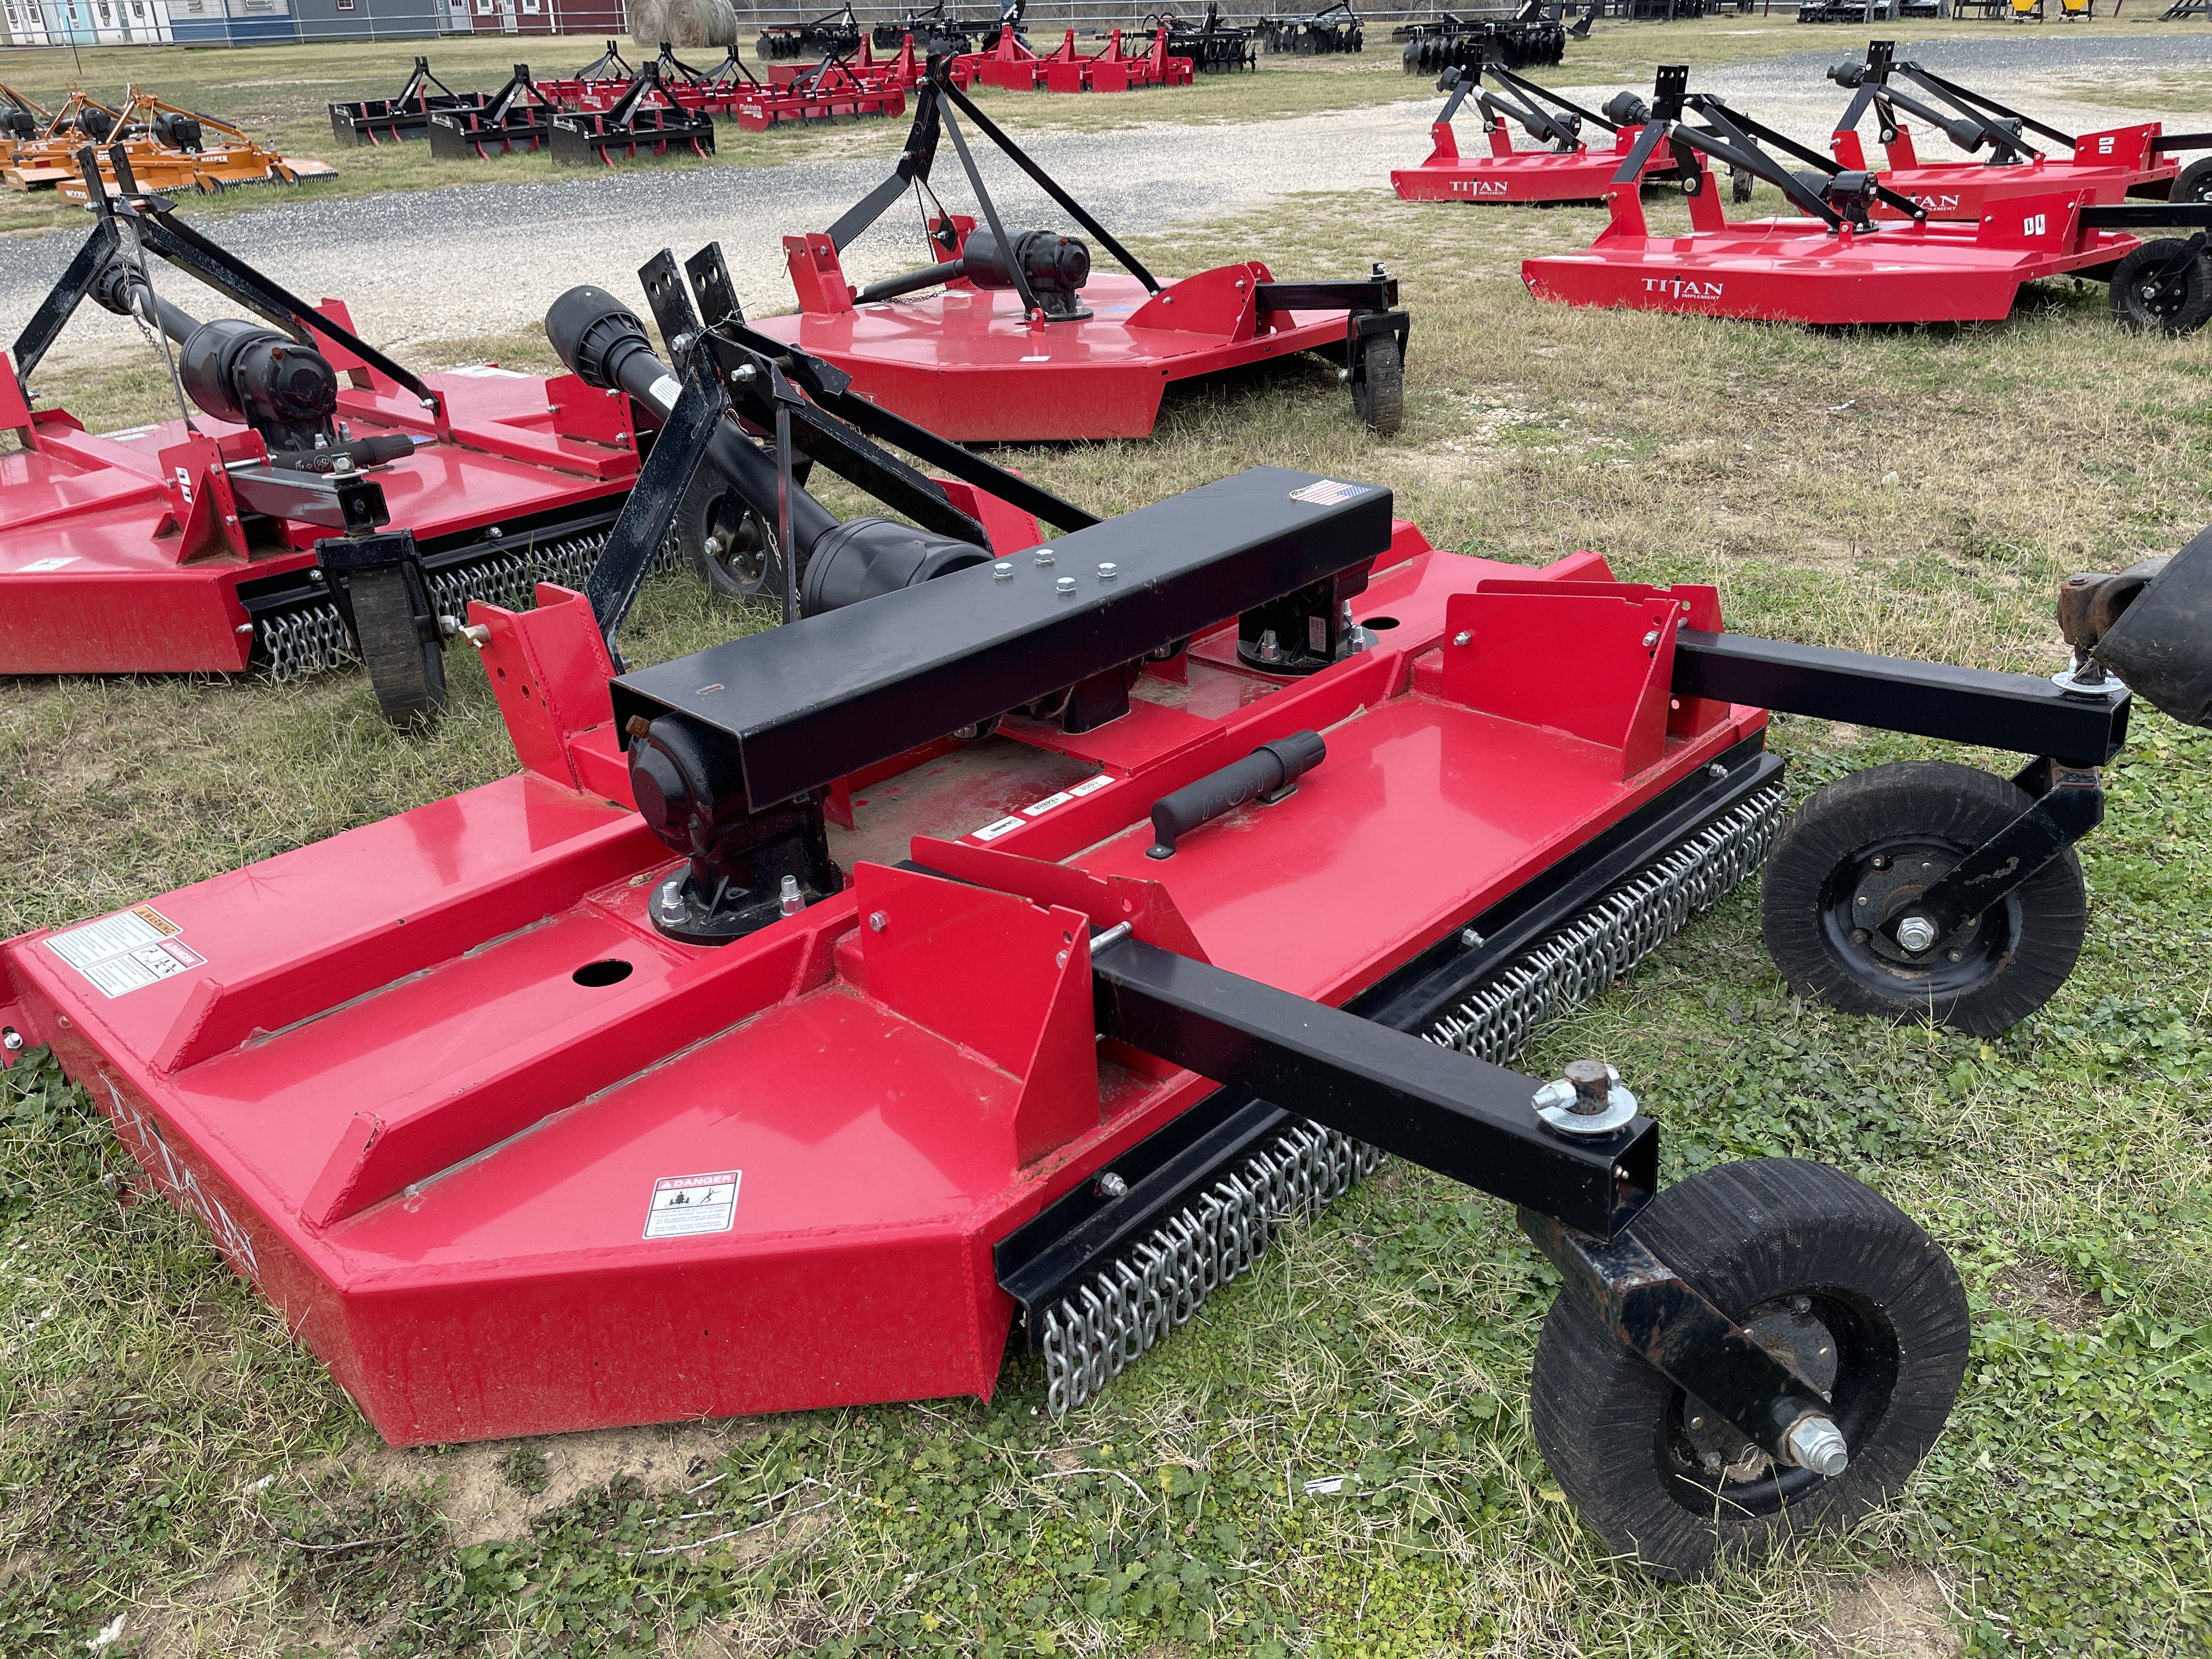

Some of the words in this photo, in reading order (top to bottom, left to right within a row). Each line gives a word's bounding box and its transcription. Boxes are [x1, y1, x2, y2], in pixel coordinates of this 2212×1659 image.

[65, 189, 88, 200] WOODS
[1449, 177, 1508, 196] TITAN
[1641, 274, 1724, 300] TITAN
[144, 913, 175, 934] WARNING
[170, 945, 196, 964] DANGER
[674, 1175, 732, 1187] DANGER
